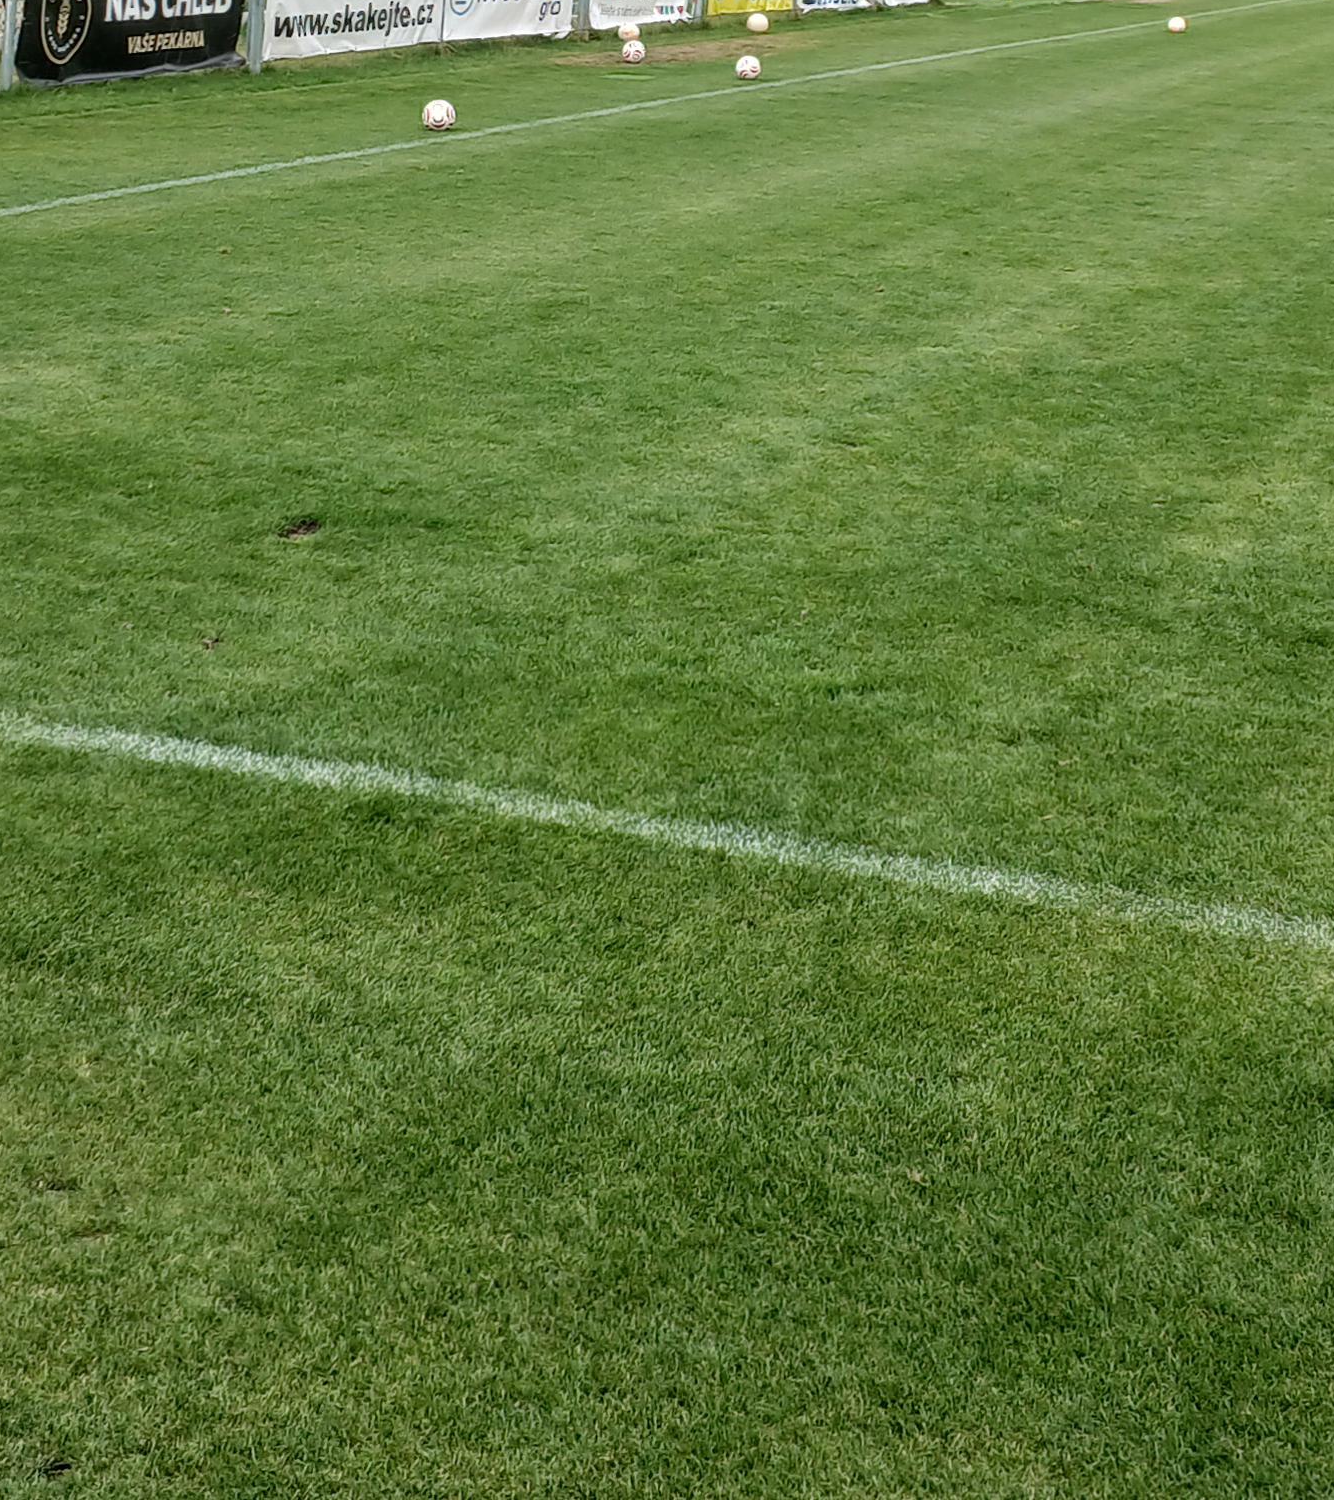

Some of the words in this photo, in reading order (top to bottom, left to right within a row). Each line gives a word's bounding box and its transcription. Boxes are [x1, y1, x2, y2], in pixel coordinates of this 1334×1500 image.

[273, 0, 435, 38] www.skakejte.cz
[127, 30, 155, 54] VAŠE
[155, 28, 205, 51] PEKÁRNA
